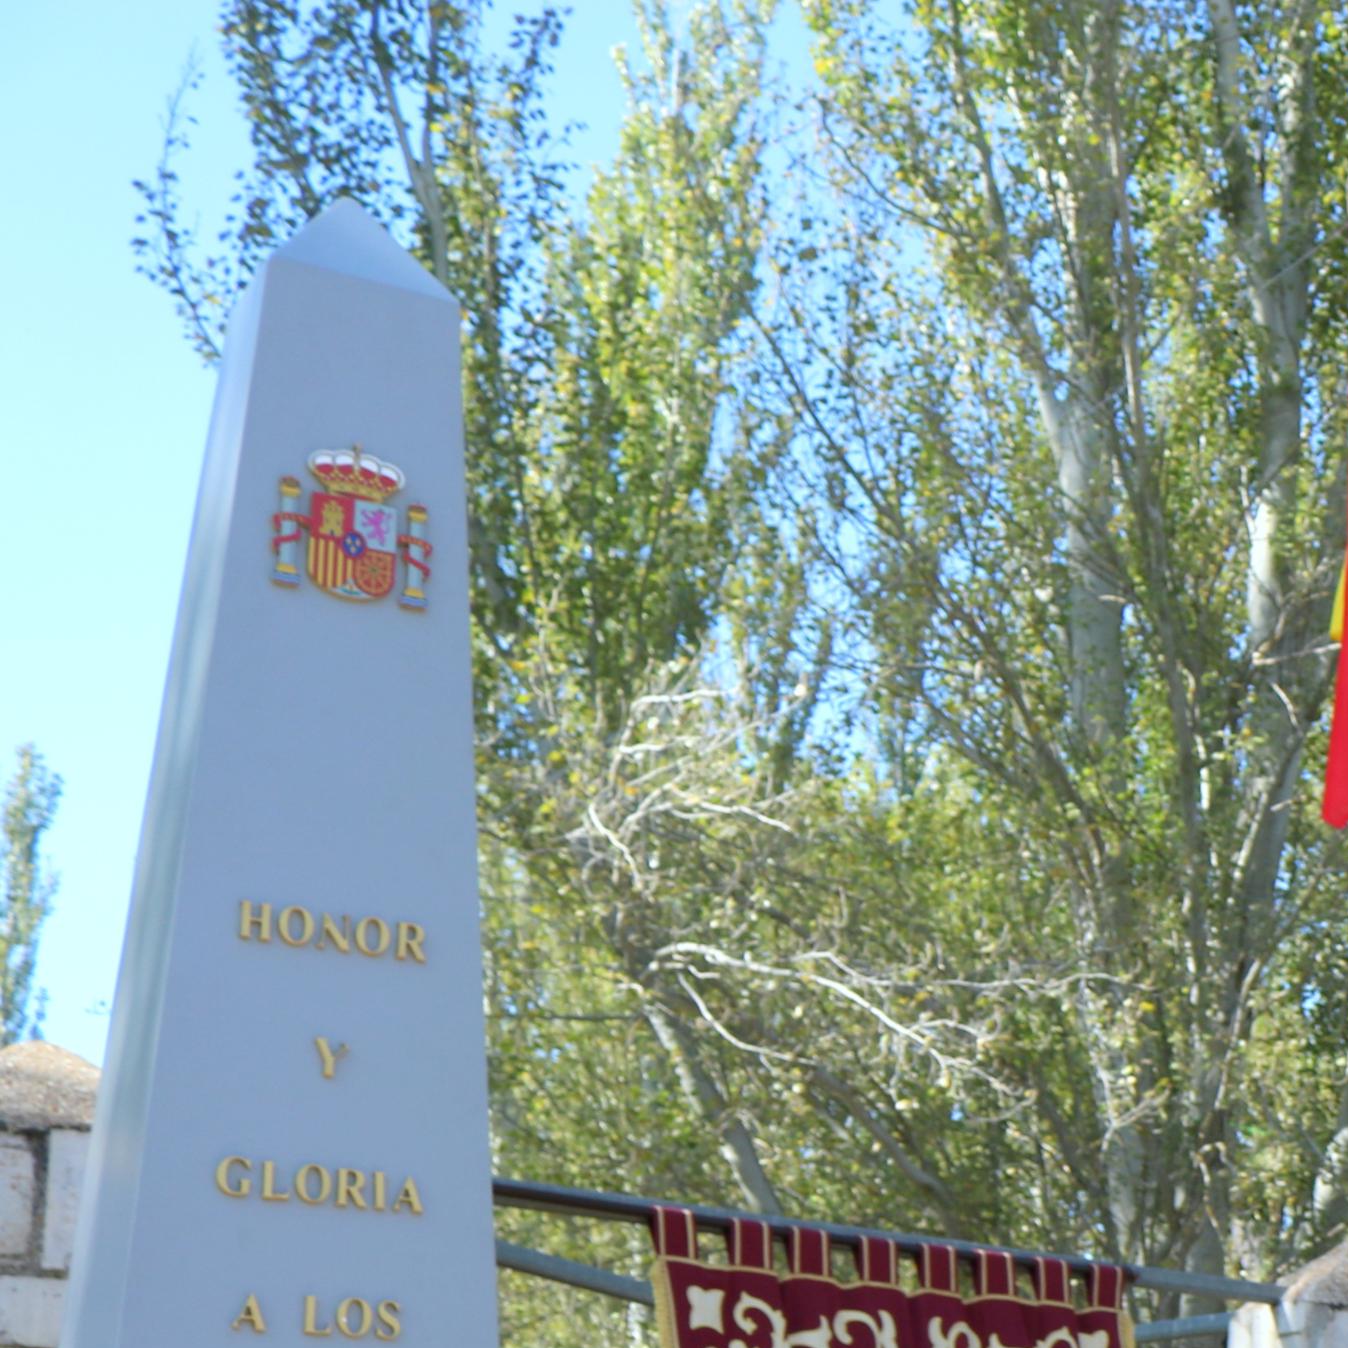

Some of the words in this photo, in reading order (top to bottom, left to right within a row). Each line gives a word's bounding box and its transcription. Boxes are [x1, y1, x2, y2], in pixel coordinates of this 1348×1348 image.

[239, 900, 426, 965] HONOR
[314, 1037, 348, 1080] Y
[215, 1156, 423, 1217] GLORIA
[231, 1294, 266, 1335] A
[303, 1295, 401, 1343] LOS
